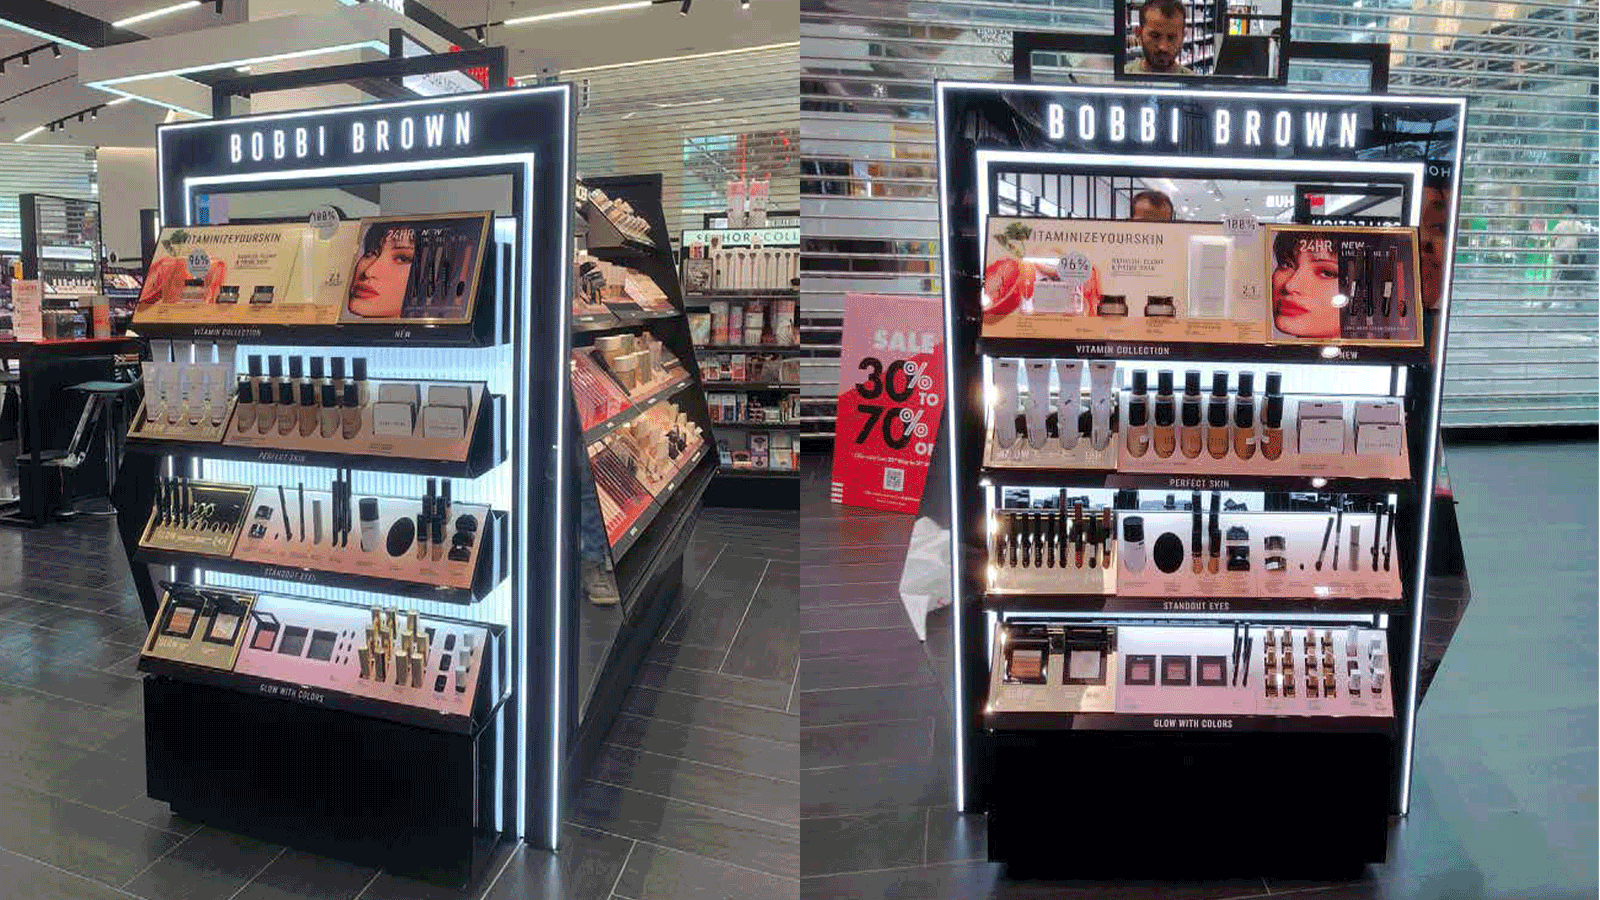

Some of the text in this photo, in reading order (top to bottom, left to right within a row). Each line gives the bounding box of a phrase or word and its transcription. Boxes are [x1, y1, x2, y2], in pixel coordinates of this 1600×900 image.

[1048, 103, 1357, 148] BOBBI BROWN
[230, 111, 470, 163] BOBBI BROWN
[1025, 230, 1164, 246] VITAMINIZEYOURSKIN
[1299, 239, 1333, 252] 24HR
[1341, 241, 1365, 250] NEW
[189, 254, 209, 266] 96%
[1061, 257, 1089, 271] 96%
[194, 328, 220, 336] VITAMIN
[872, 327, 936, 354] SALE
[1075, 345, 1170, 355] VITAMIN COLLECTION
[855, 356, 932, 403] 30%
[918, 392, 939, 406] TO
[855, 404, 929, 450] 70%
[1170, 478, 1230, 489] PERFECT SKIN
[1163, 601, 1230, 611] STANDOUT EYES
[259, 683, 325, 704] GLOW WITH COLORS
[1153, 718, 1234, 729] GLOW WITH COLORS
